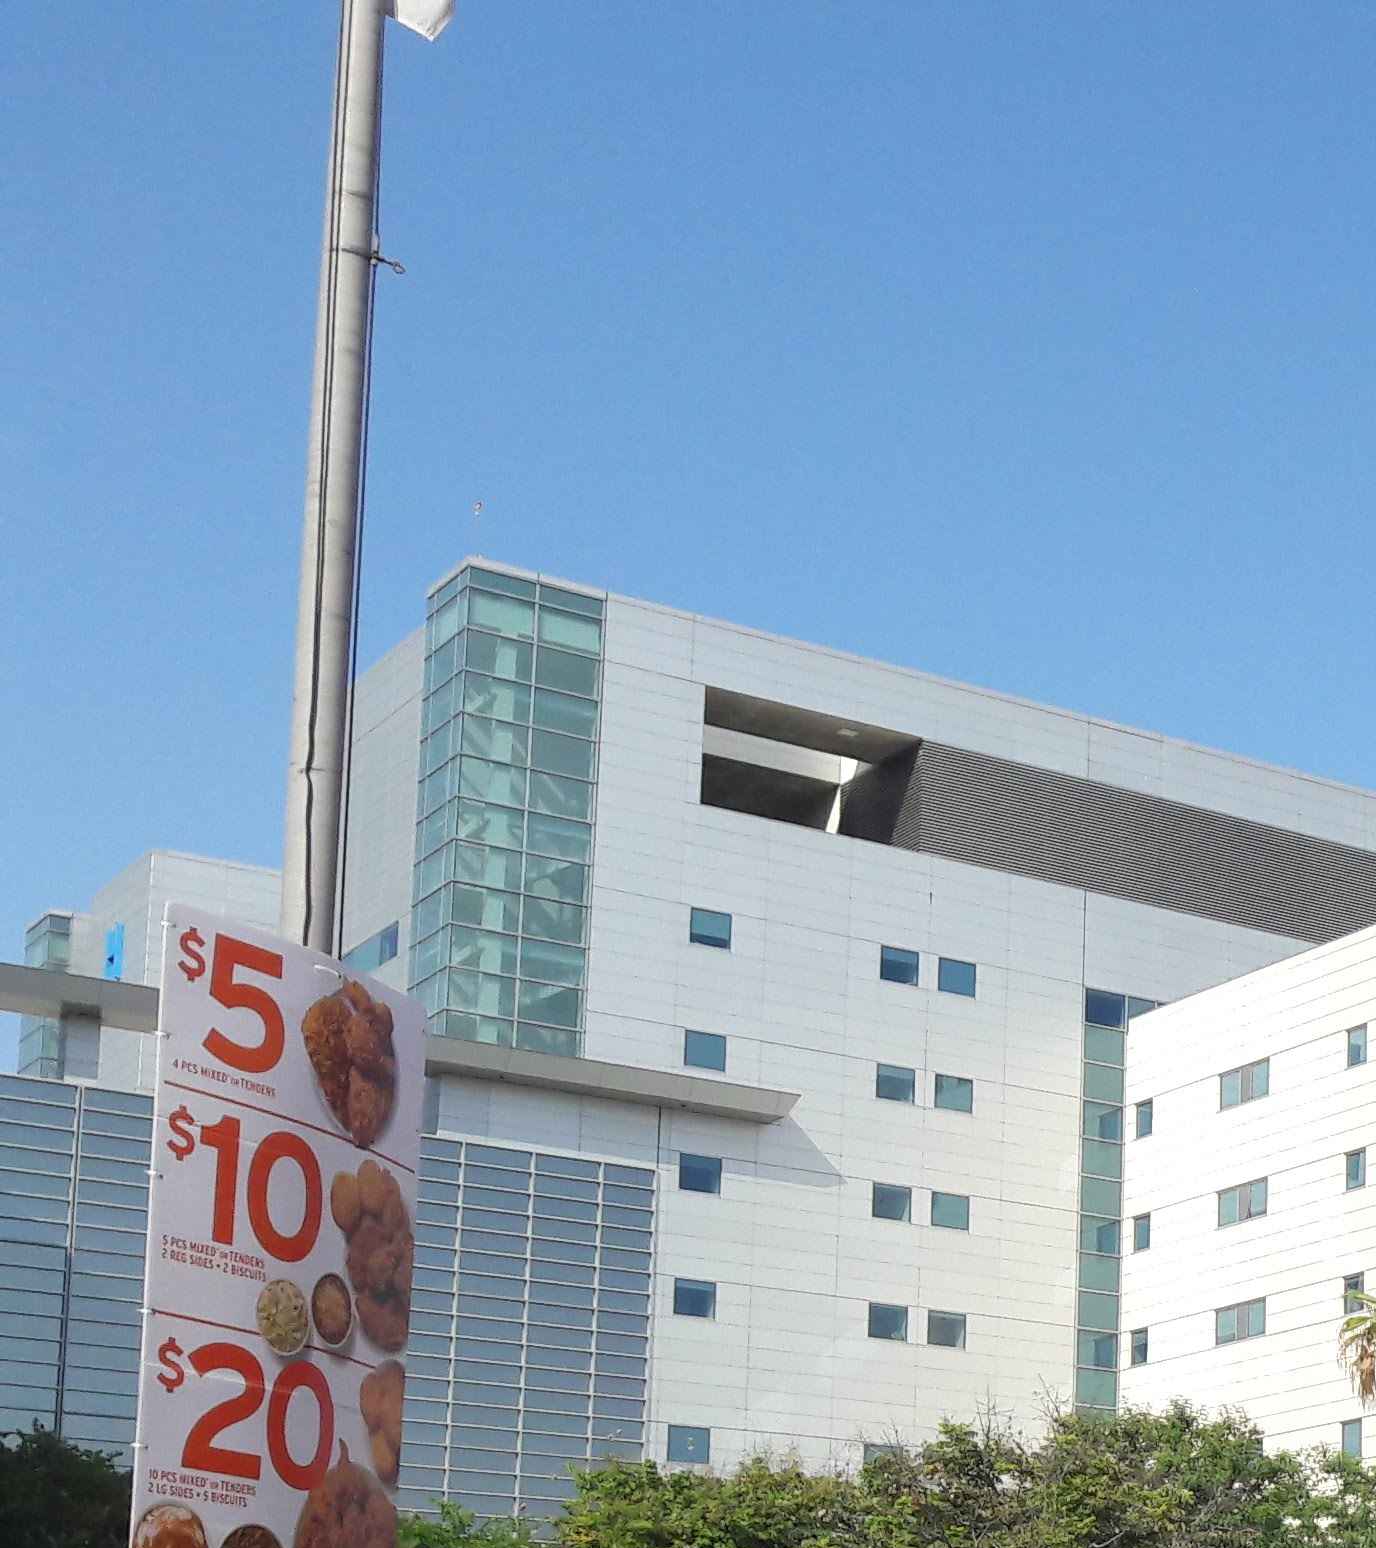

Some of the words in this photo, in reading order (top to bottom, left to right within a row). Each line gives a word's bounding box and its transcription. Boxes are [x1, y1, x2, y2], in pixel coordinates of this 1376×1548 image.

[178, 926, 285, 1074] $5
[172, 1058, 178, 1069] 4
[181, 1060, 198, 1074] PCS
[166, 1103, 323, 1263] $10
[161, 1248, 168, 1259] 2
[170, 1249, 186, 1263] REG
[189, 1254, 214, 1269] SIDES
[222, 1262, 229, 1274] 2
[231, 1264, 266, 1282] BISCUITS
[162, 1234, 168, 1246] 5
[170, 1236, 187, 1250] PCS
[228, 1251, 265, 1269] TENDERS
[157, 1337, 335, 1492] $20
[147, 1482, 154, 1493] 2
[156, 1483, 167, 1495] LG
[169, 1485, 194, 1499] SIDES
[203, 1490, 209, 1502] 5
[211, 1492, 248, 1508] BISCUITS
[149, 1468, 159, 1480] 10
[160, 1470, 178, 1484] PCS
[220, 1480, 257, 1497] TENDERS
